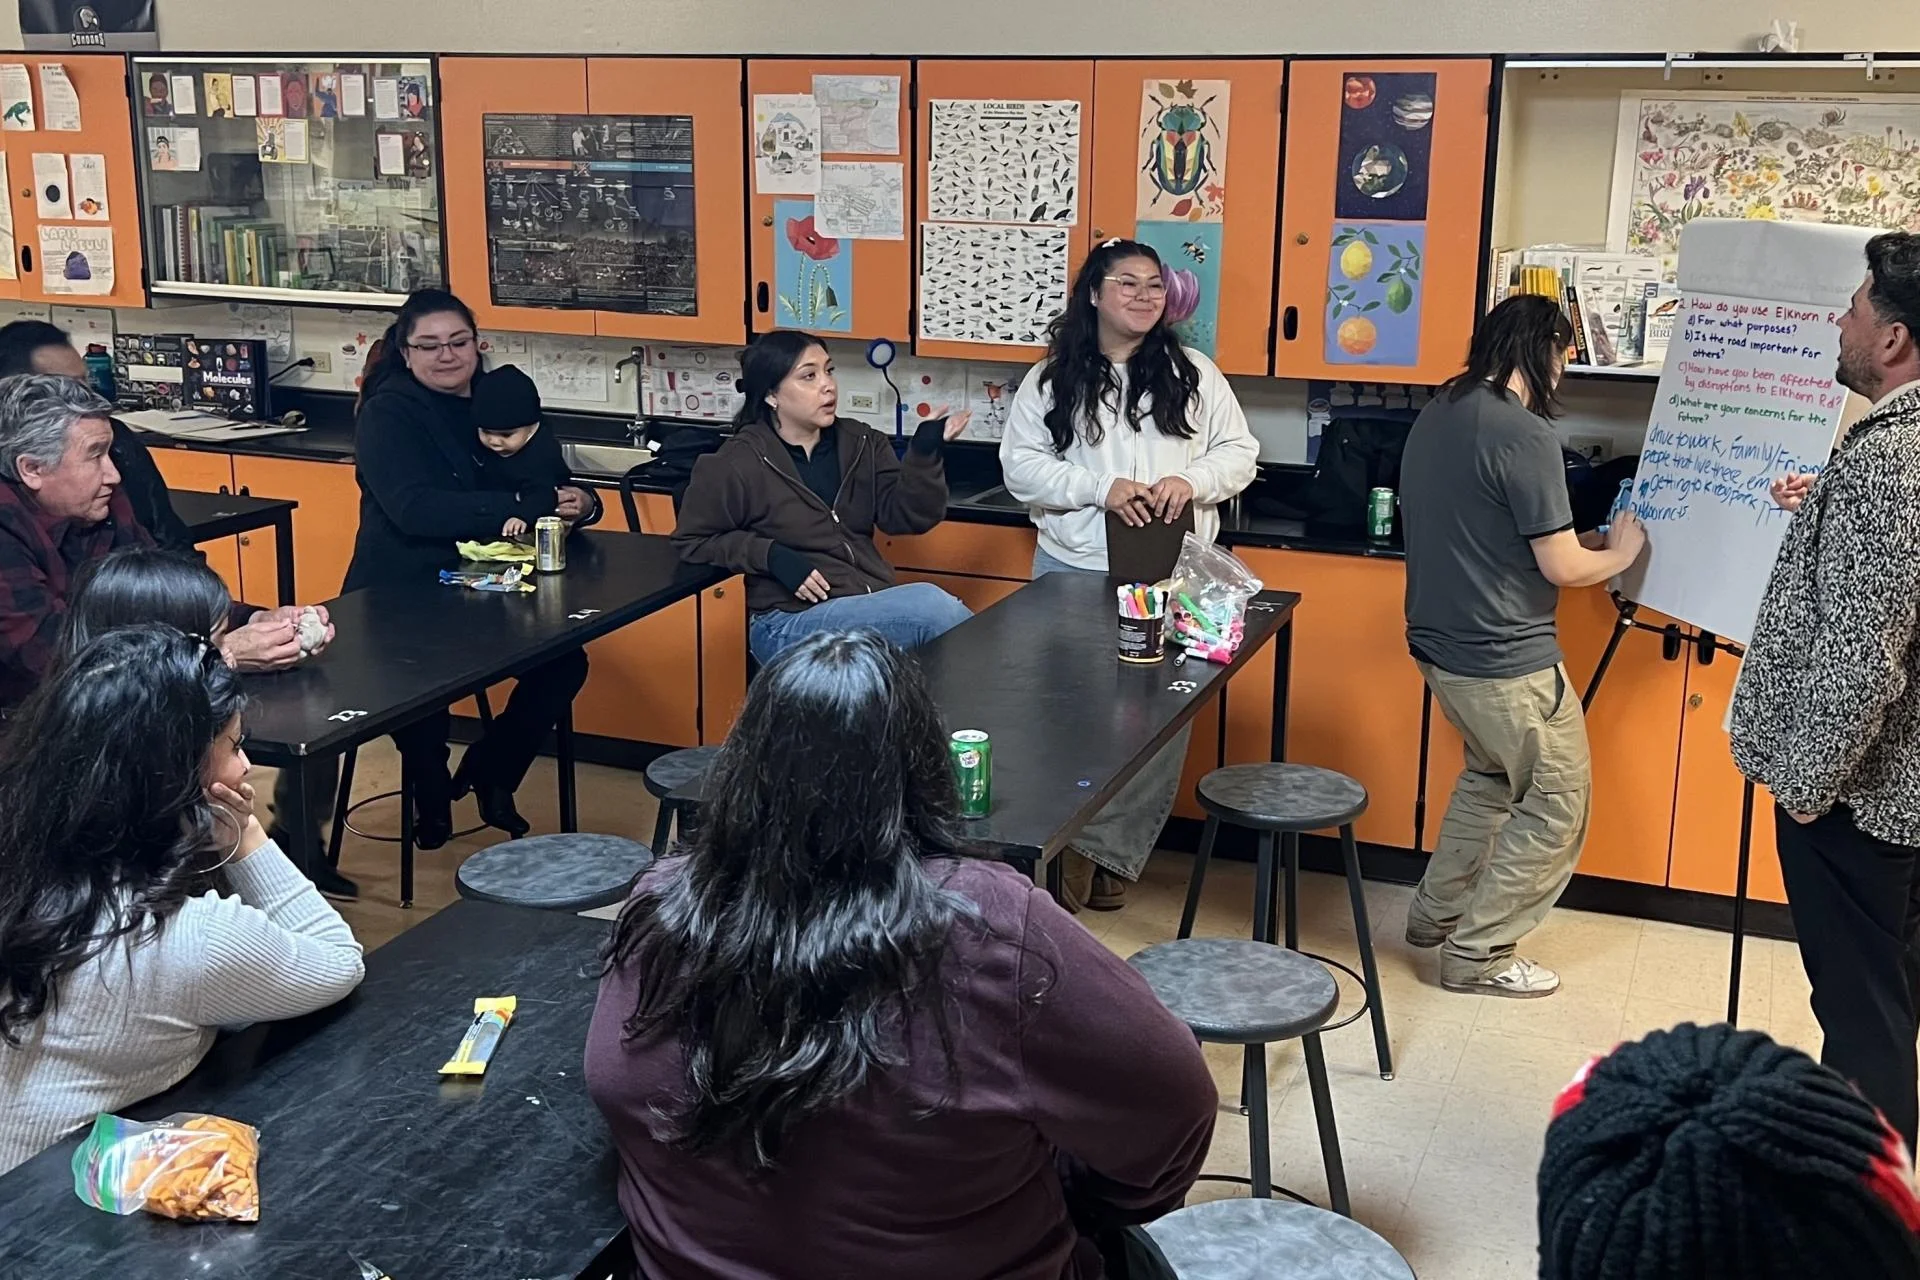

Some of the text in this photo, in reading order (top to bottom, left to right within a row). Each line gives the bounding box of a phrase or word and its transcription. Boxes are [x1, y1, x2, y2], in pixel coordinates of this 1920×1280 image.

[983, 102, 1004, 110] LOCAL
[41, 227, 80, 241] LAPIS
[1691, 297, 1712, 310] How
[1716, 302, 1728, 312] do
[1733, 304, 1749, 318] you
[1751, 305, 1769, 316] use
[1720, 318, 1743, 328] what
[1746, 322, 1798, 337] purposes?
[1709, 332, 1724, 344] the
[1727, 337, 1747, 347] road
[1750, 341, 1798, 355] important
[1692, 348, 1726, 360] others?
[202, 371, 252, 385] Molecules
[1684, 375, 1695, 392] by
[1697, 379, 1751, 394] disruptions
[1756, 383, 1767, 394] to
[1708, 366, 1730, 377] have
[1732, 368, 1749, 383] you
[1752, 367, 1775, 381] been
[1780, 372, 1834, 389] affected
[1703, 401, 1718, 411] are
[1720, 403, 1742, 418] your
[1744, 406, 1786, 421] concerns
[1808, 412, 1827, 426] the
[1648, 424, 1674, 446] drive
[1641, 449, 1671, 471] people
[1672, 452, 1693, 470] that
[1693, 455, 1712, 475] live
